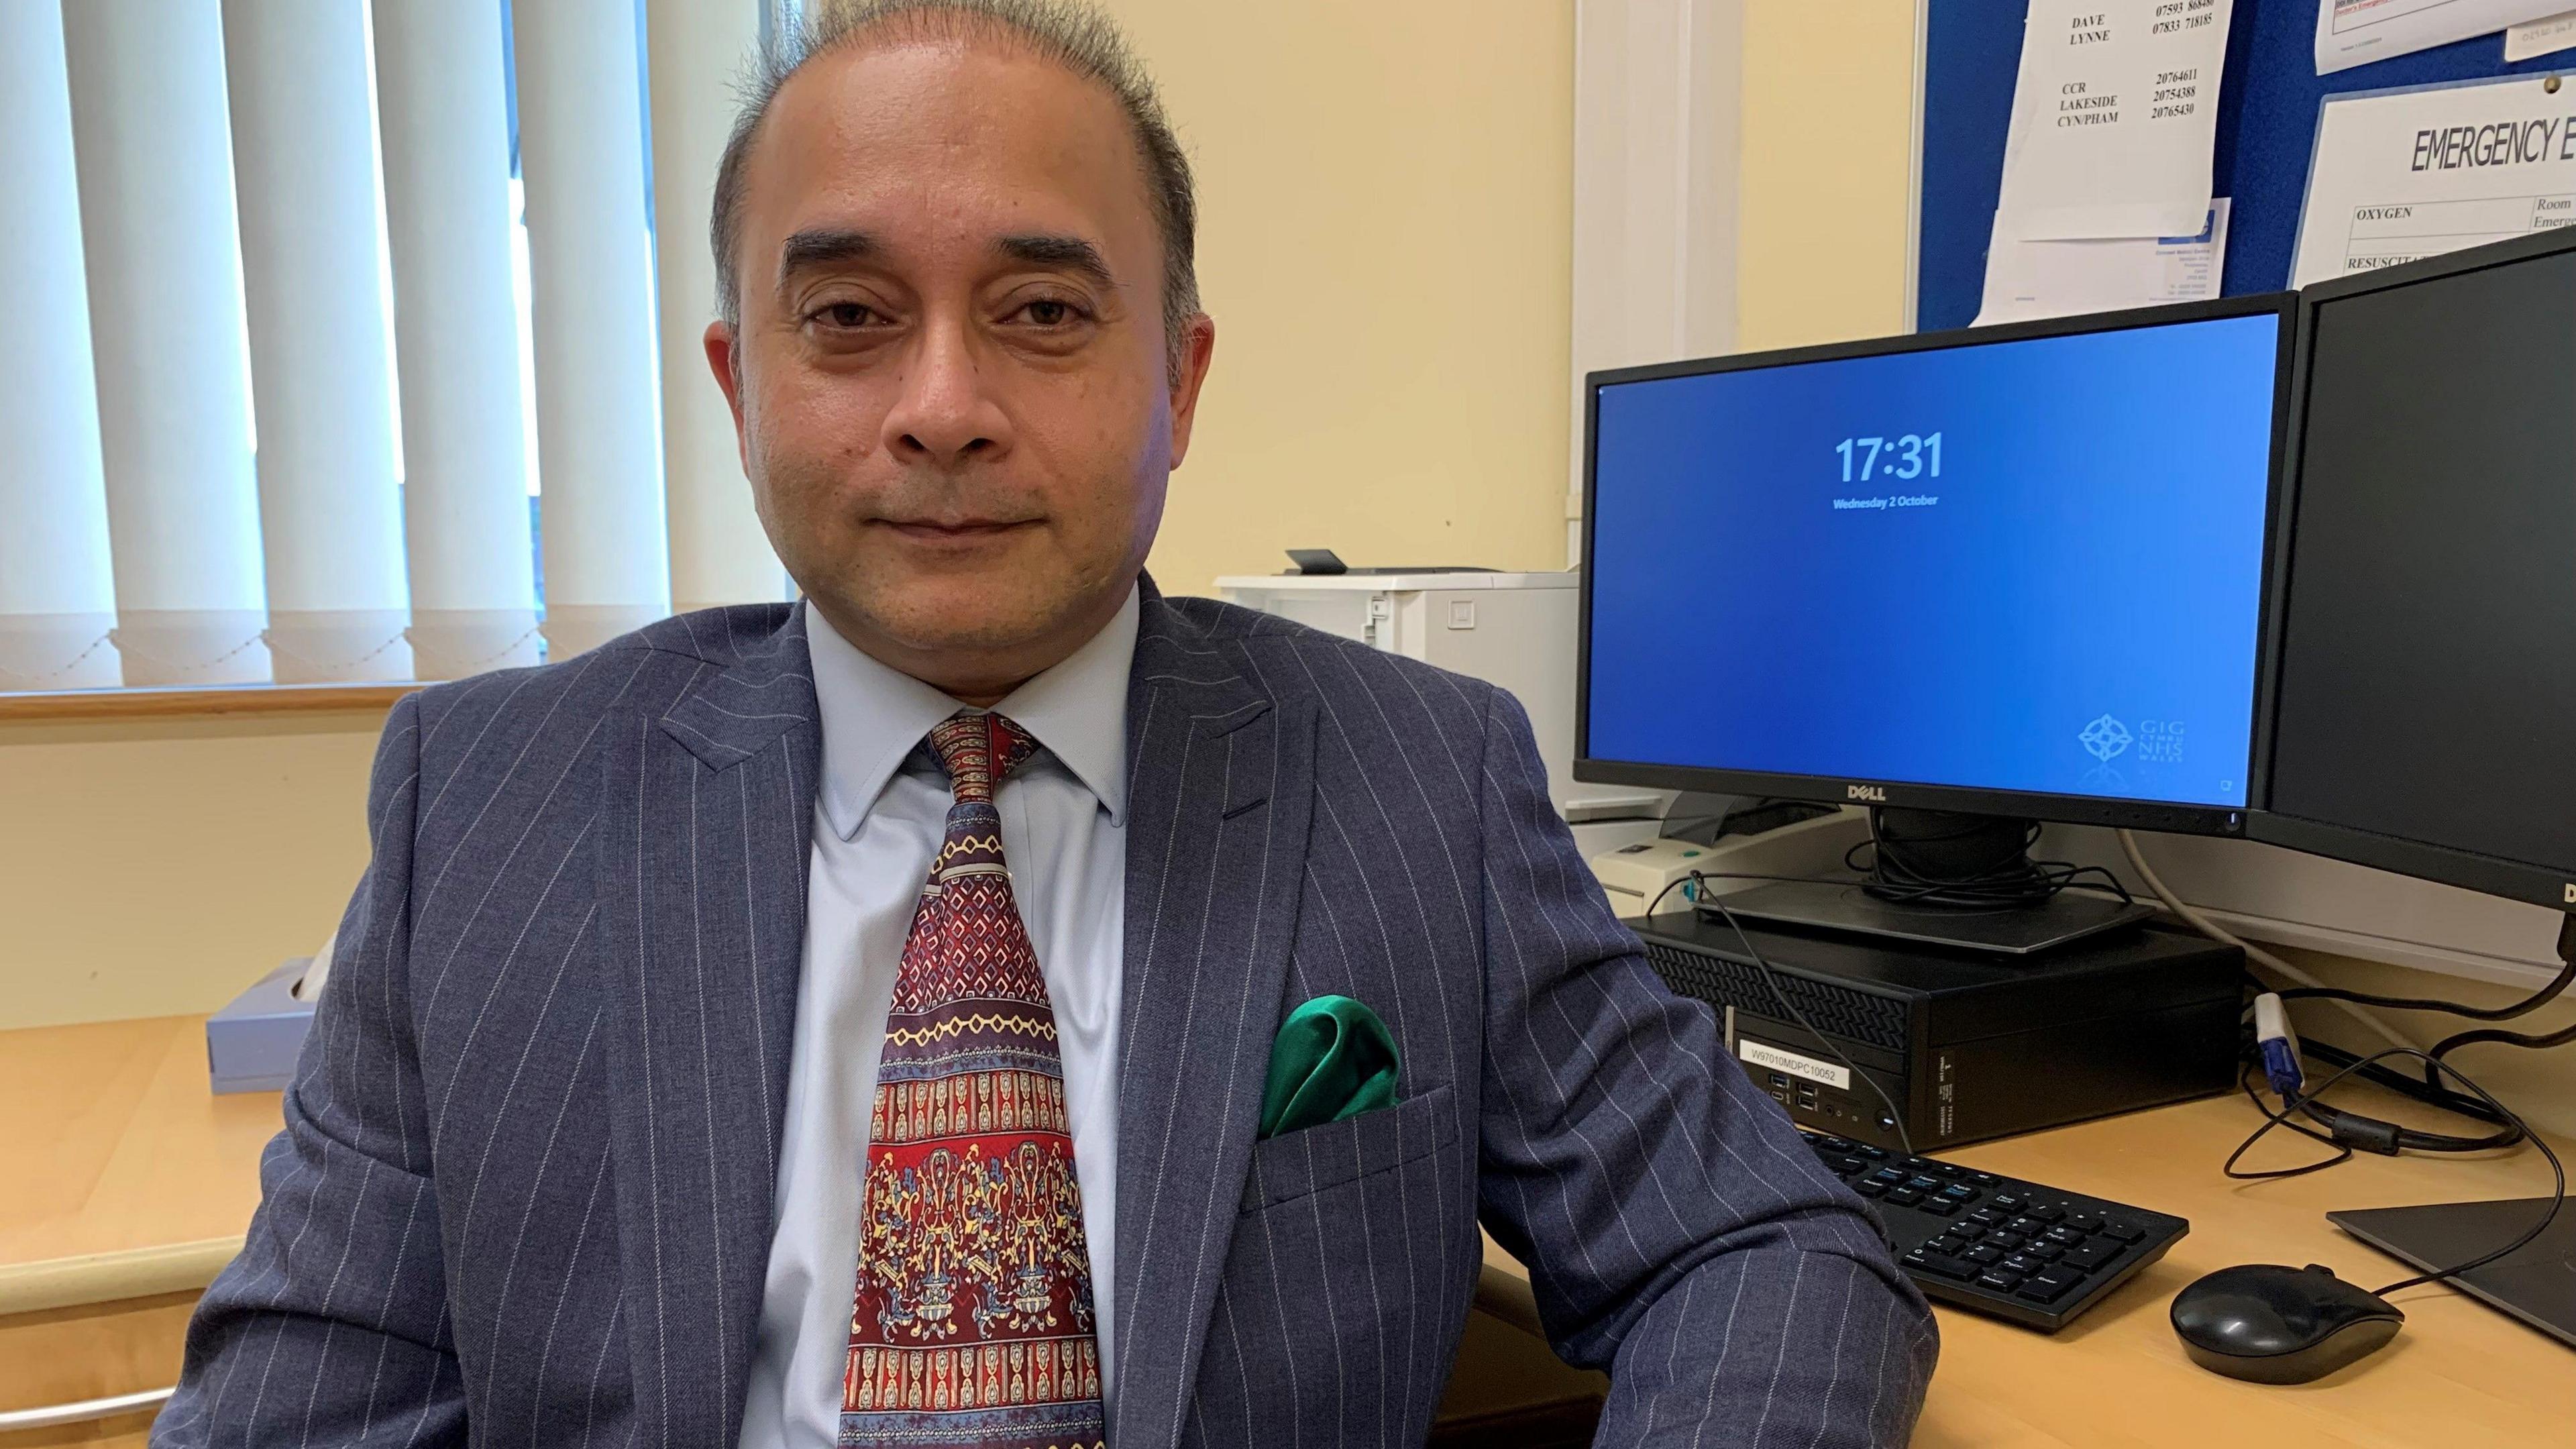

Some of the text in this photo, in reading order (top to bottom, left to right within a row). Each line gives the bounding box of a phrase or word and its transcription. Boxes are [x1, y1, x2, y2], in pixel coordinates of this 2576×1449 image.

[2072, 13, 2105, 29] DAVE
[2156, 2, 2183, 17] 07593
[2070, 12, 2212, 45] LYNNE 07833 718185
[2062, 68, 2198, 95] CCR 20764611
[2059, 85, 2196, 111] LAKESIDE 20754388
[2057, 103, 2194, 127] CYN/PHAM 20765430
[2412, 117, 2560, 172] EMERGENCY
[2356, 207, 2413, 220] OXYGEN
[2537, 199, 2571, 210] Room
[1835, 431, 1941, 482] 17:31
[1833, 494, 1939, 511] Wednesday 2 October
[2141, 720, 2184, 735] GIG
[2139, 741, 2183, 756] NHS
[1847, 785, 1886, 801] DELL
[1752, 1049, 1835, 1081] W97010MDPC10052
